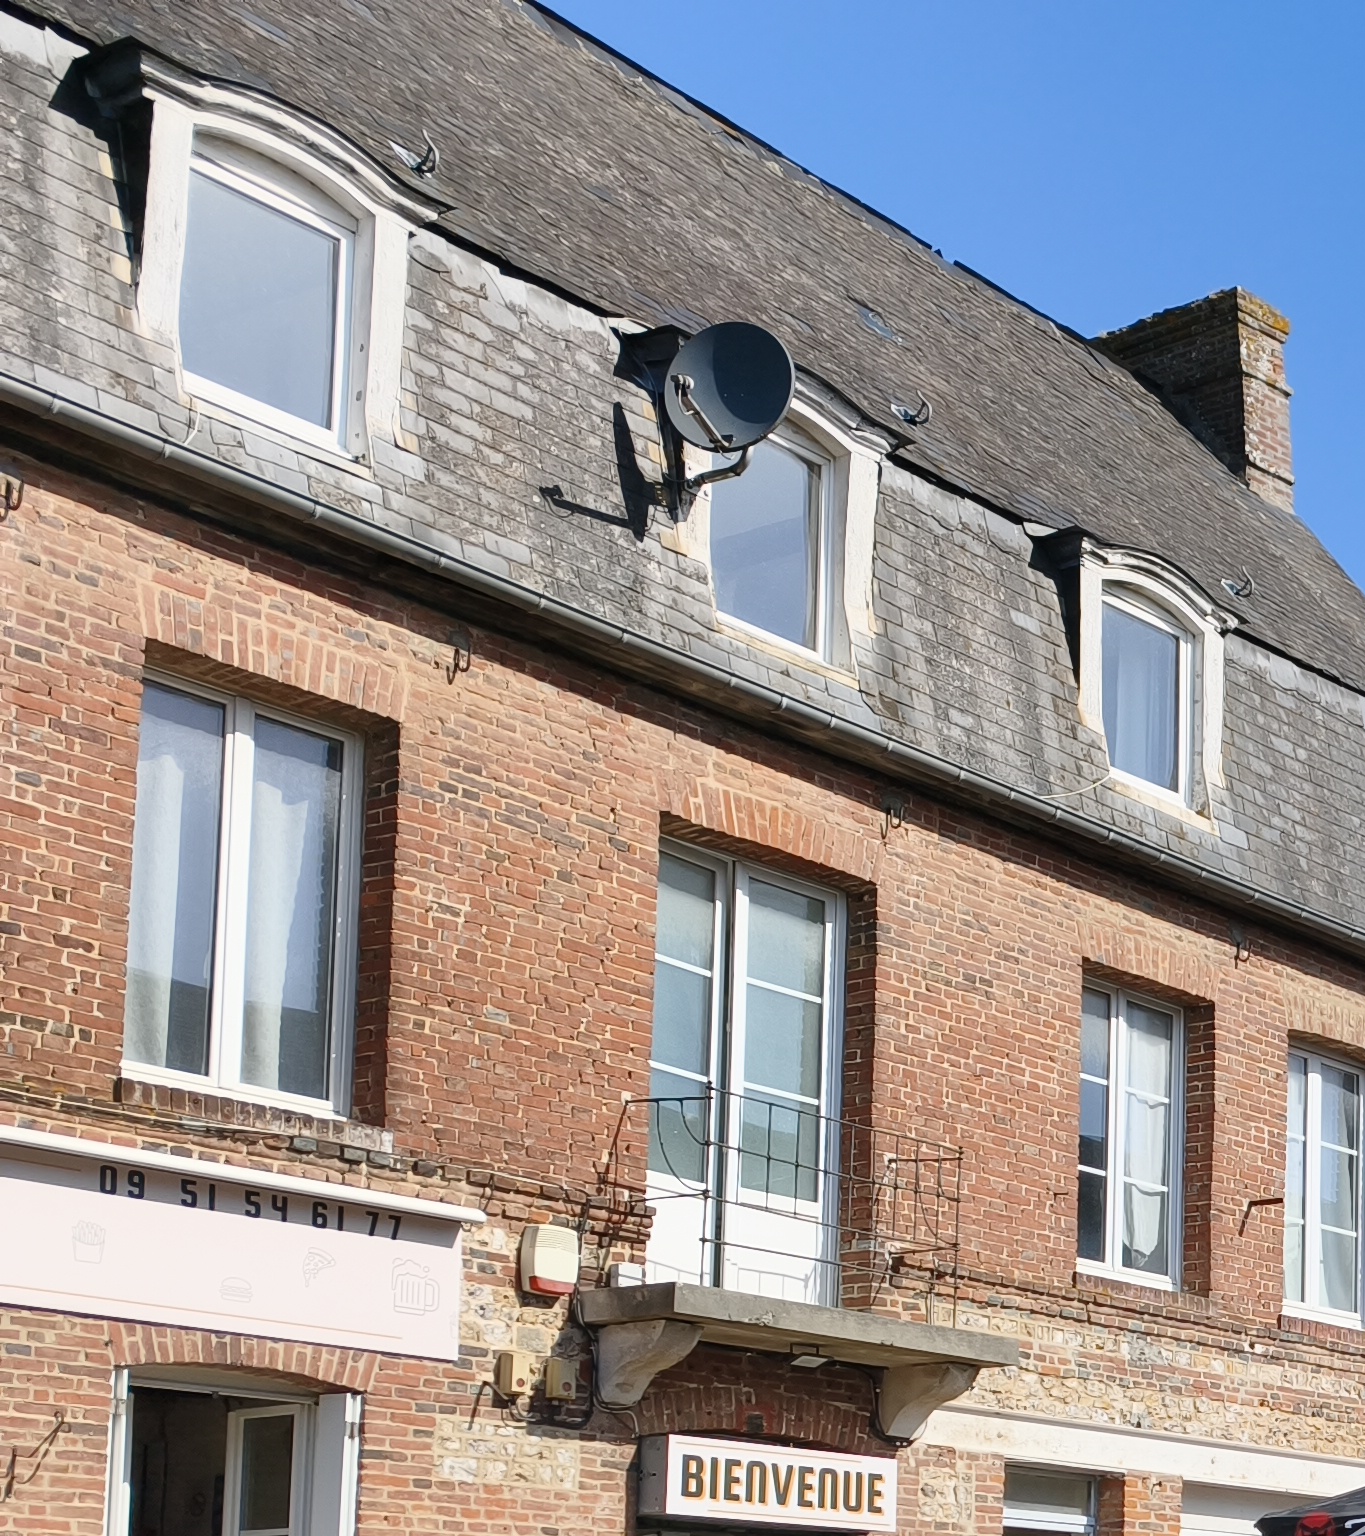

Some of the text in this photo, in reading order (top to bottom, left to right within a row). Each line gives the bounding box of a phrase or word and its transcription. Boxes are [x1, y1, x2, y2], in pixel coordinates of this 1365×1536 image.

[99, 1164, 402, 1240] 09 51 54 61 77
[681, 1454, 884, 1516] BIENVENUE
